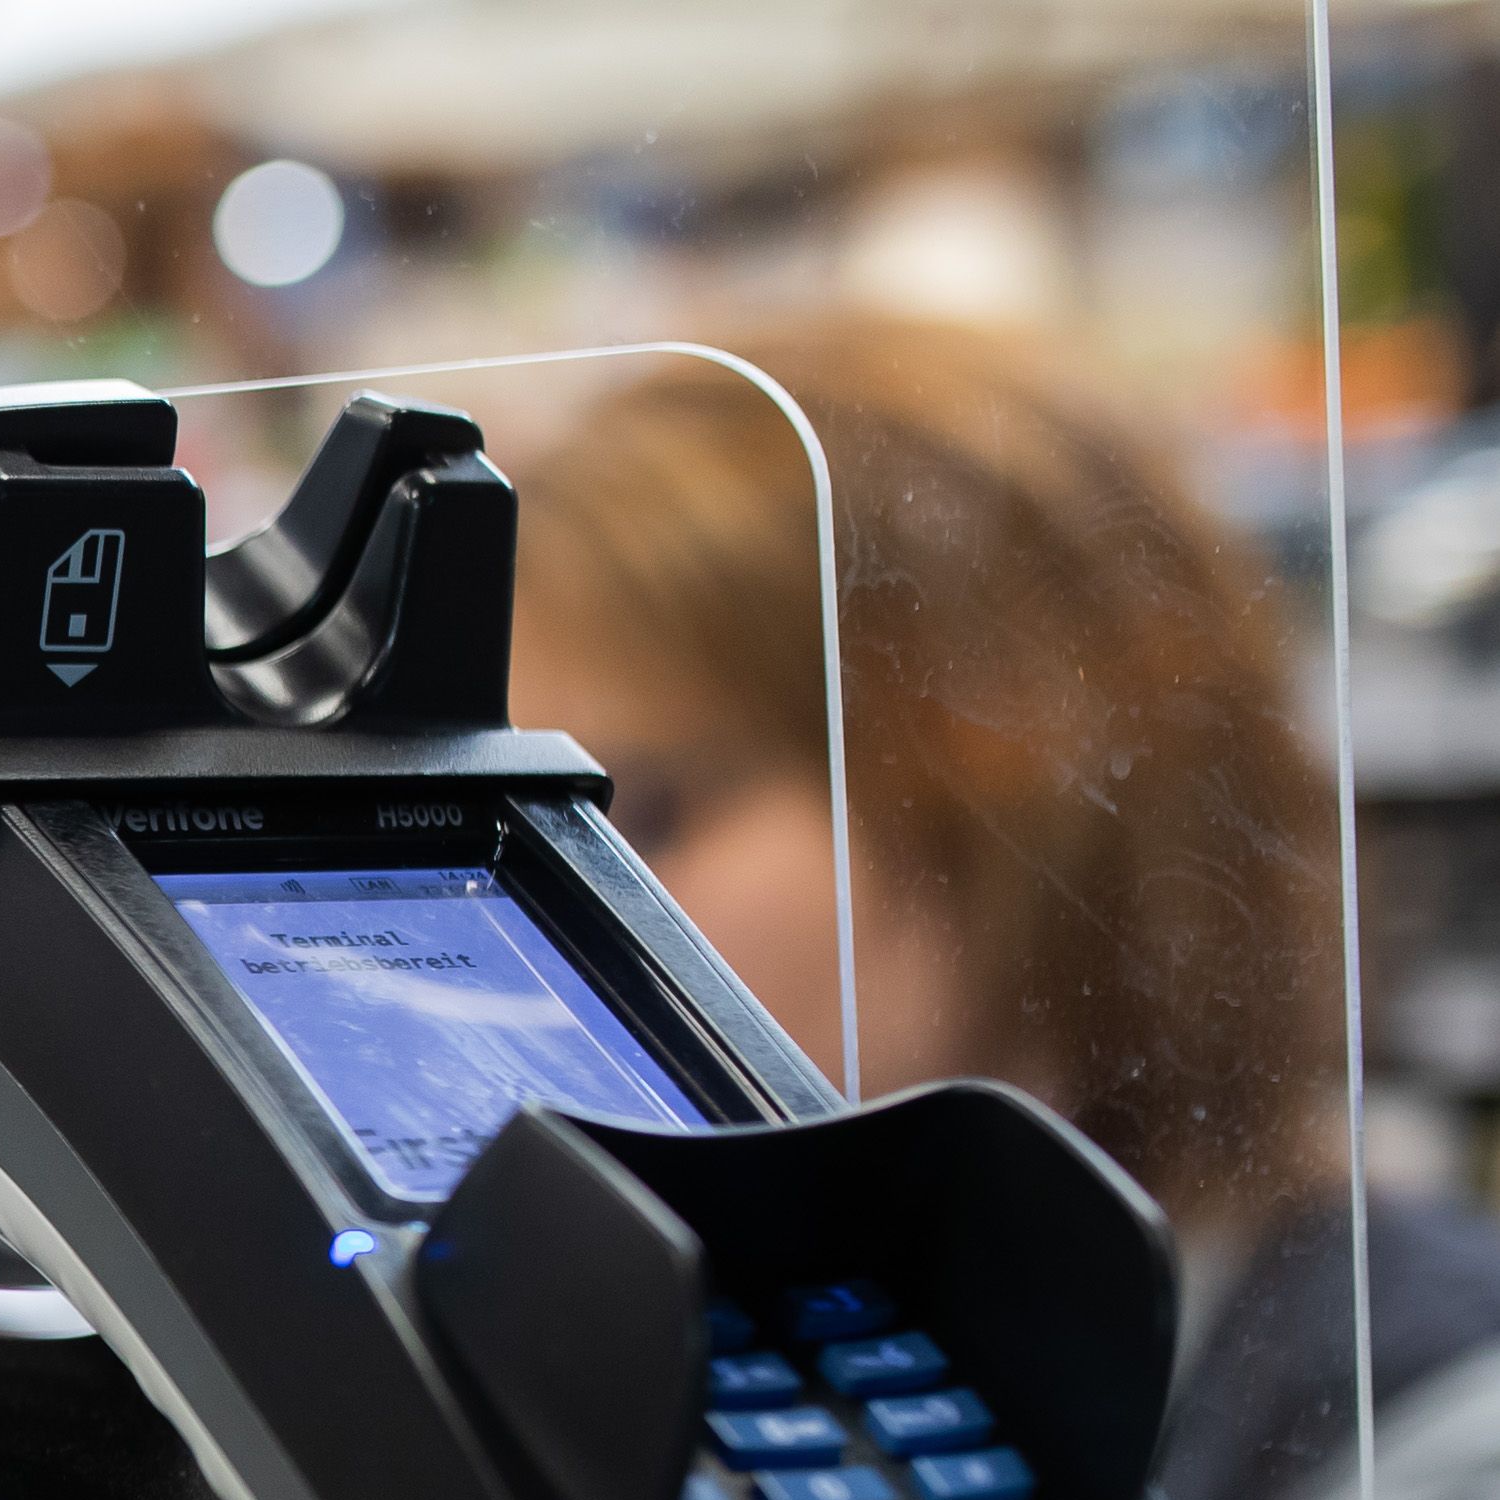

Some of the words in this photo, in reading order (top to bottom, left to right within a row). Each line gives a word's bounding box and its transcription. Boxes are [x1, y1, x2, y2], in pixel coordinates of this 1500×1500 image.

[376, 803, 464, 828] H5000
[269, 930, 410, 949] Terminal
[239, 951, 478, 975] betriebsbereit
